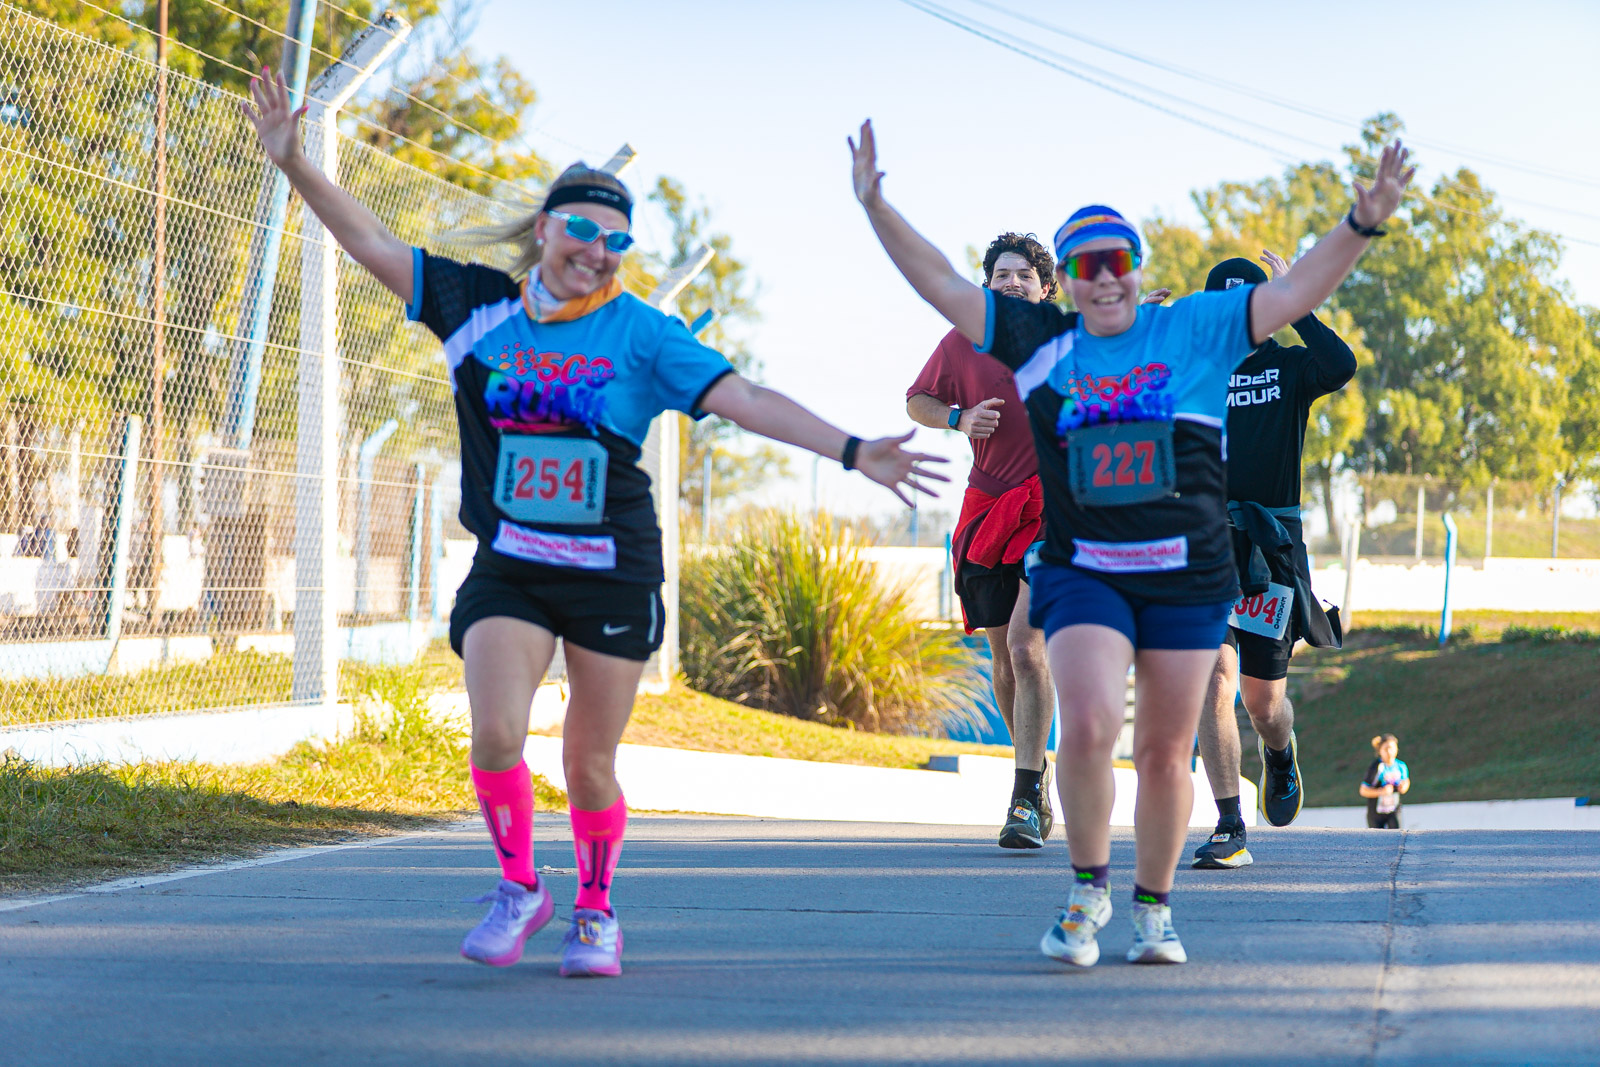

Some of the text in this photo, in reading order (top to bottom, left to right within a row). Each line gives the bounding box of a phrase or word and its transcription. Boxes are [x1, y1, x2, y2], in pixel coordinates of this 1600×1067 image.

[1228, 368, 1280, 388] NDER
[1226, 385, 1281, 407] MOUR
[514, 456, 584, 501] 254
[1092, 440, 1155, 487] 227
[1234, 592, 1279, 625] 304
[1273, 596, 1287, 630] EXACTO
